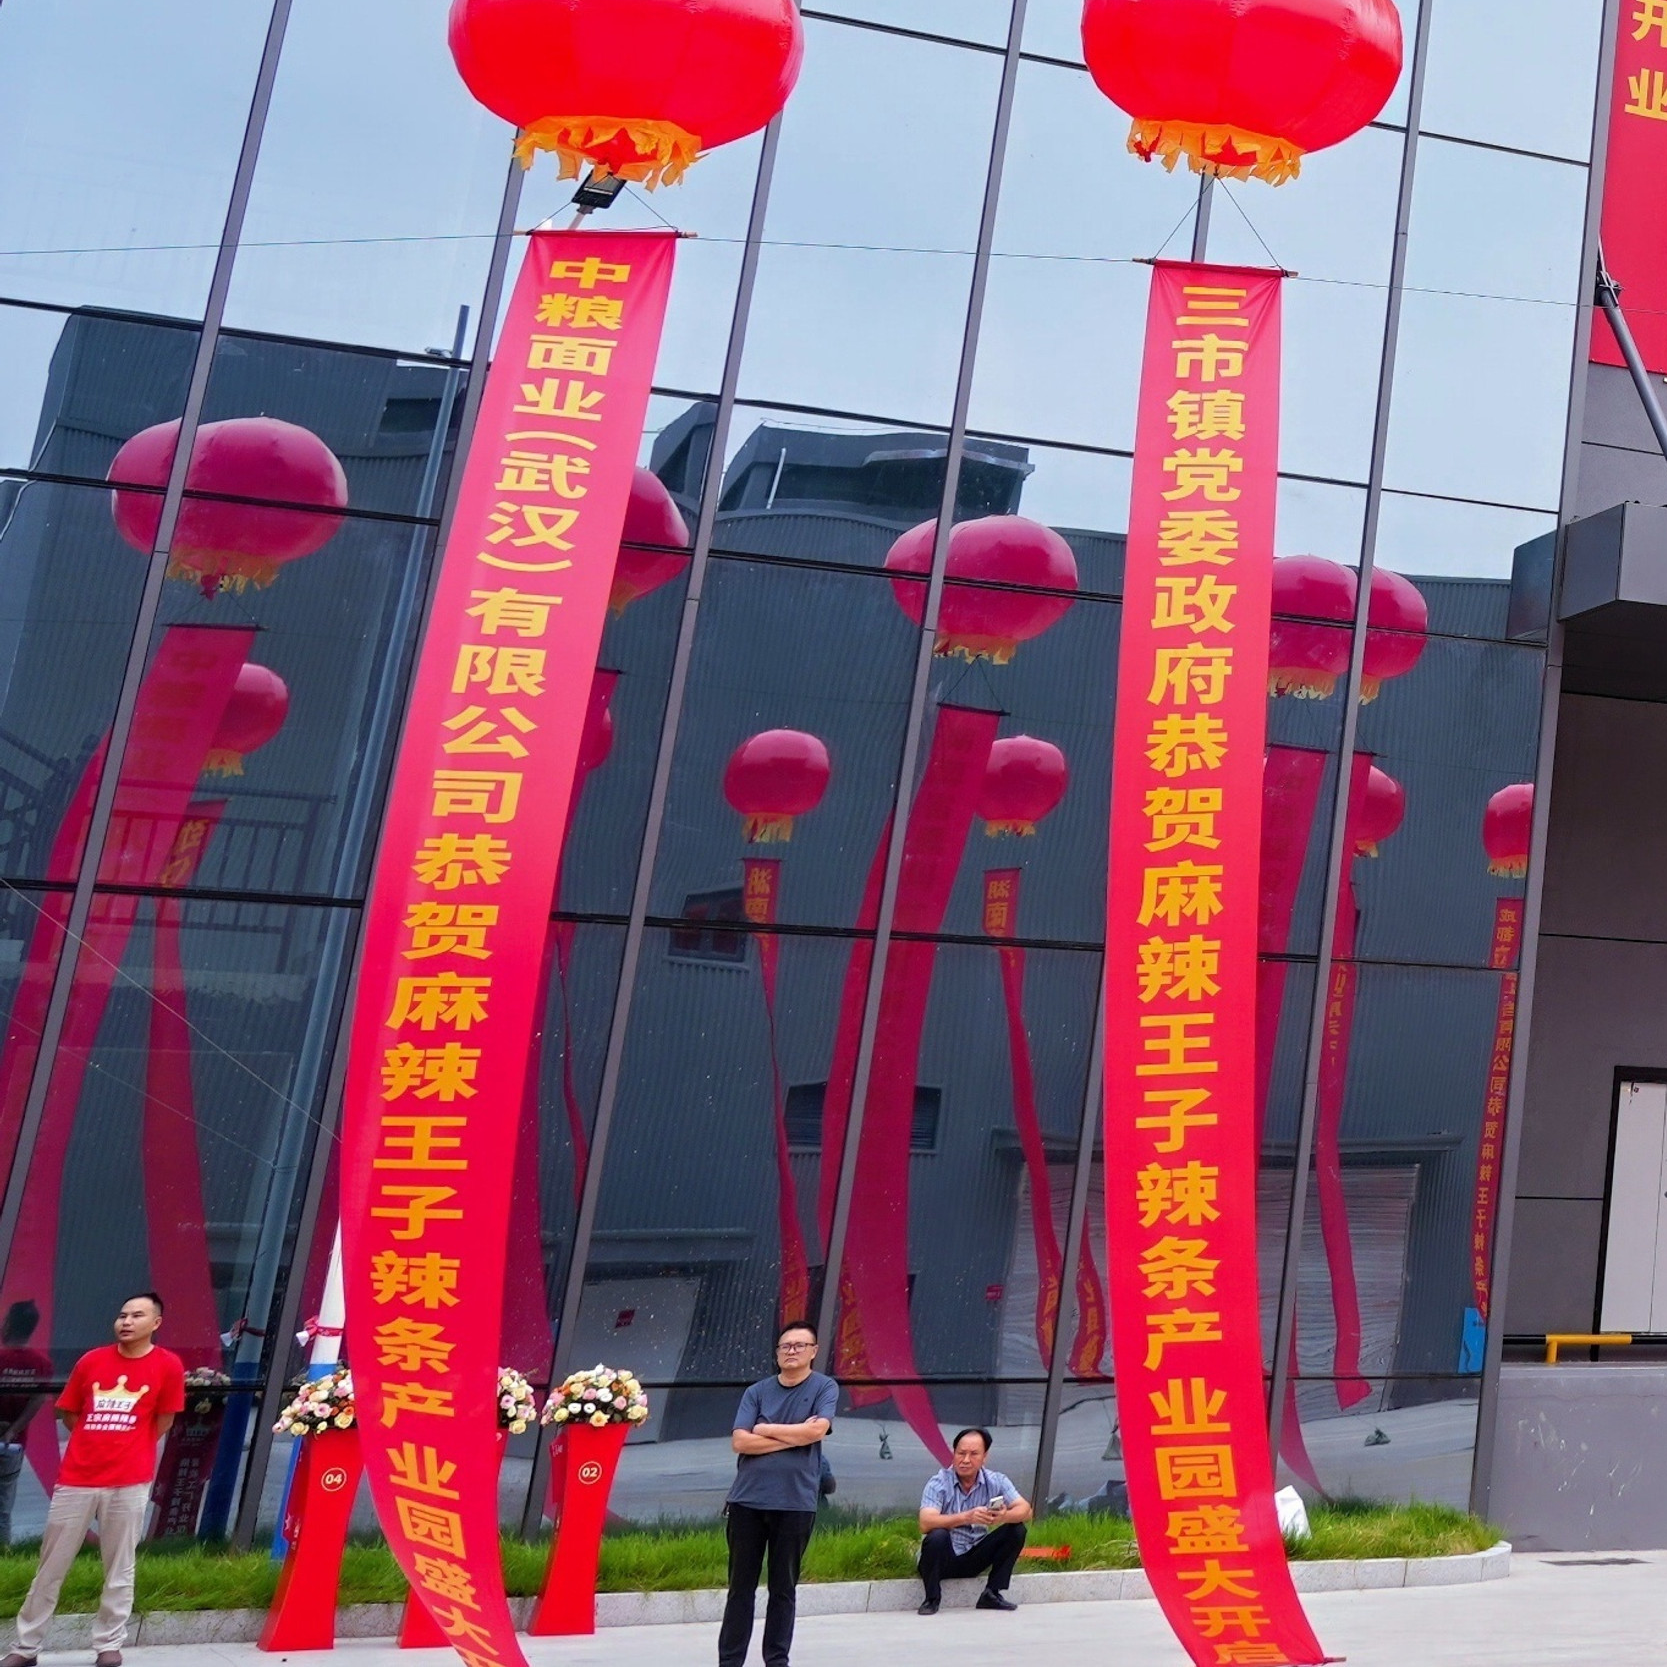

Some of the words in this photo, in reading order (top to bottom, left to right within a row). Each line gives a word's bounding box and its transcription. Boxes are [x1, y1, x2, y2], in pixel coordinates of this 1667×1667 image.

[1135, 285, 1287, 1664] 三市镇党委政府恭贺麻辣王子辣条产业园盛大开启
[325, 1472, 344, 1487] 04
[580, 1464, 598, 1480] 02
